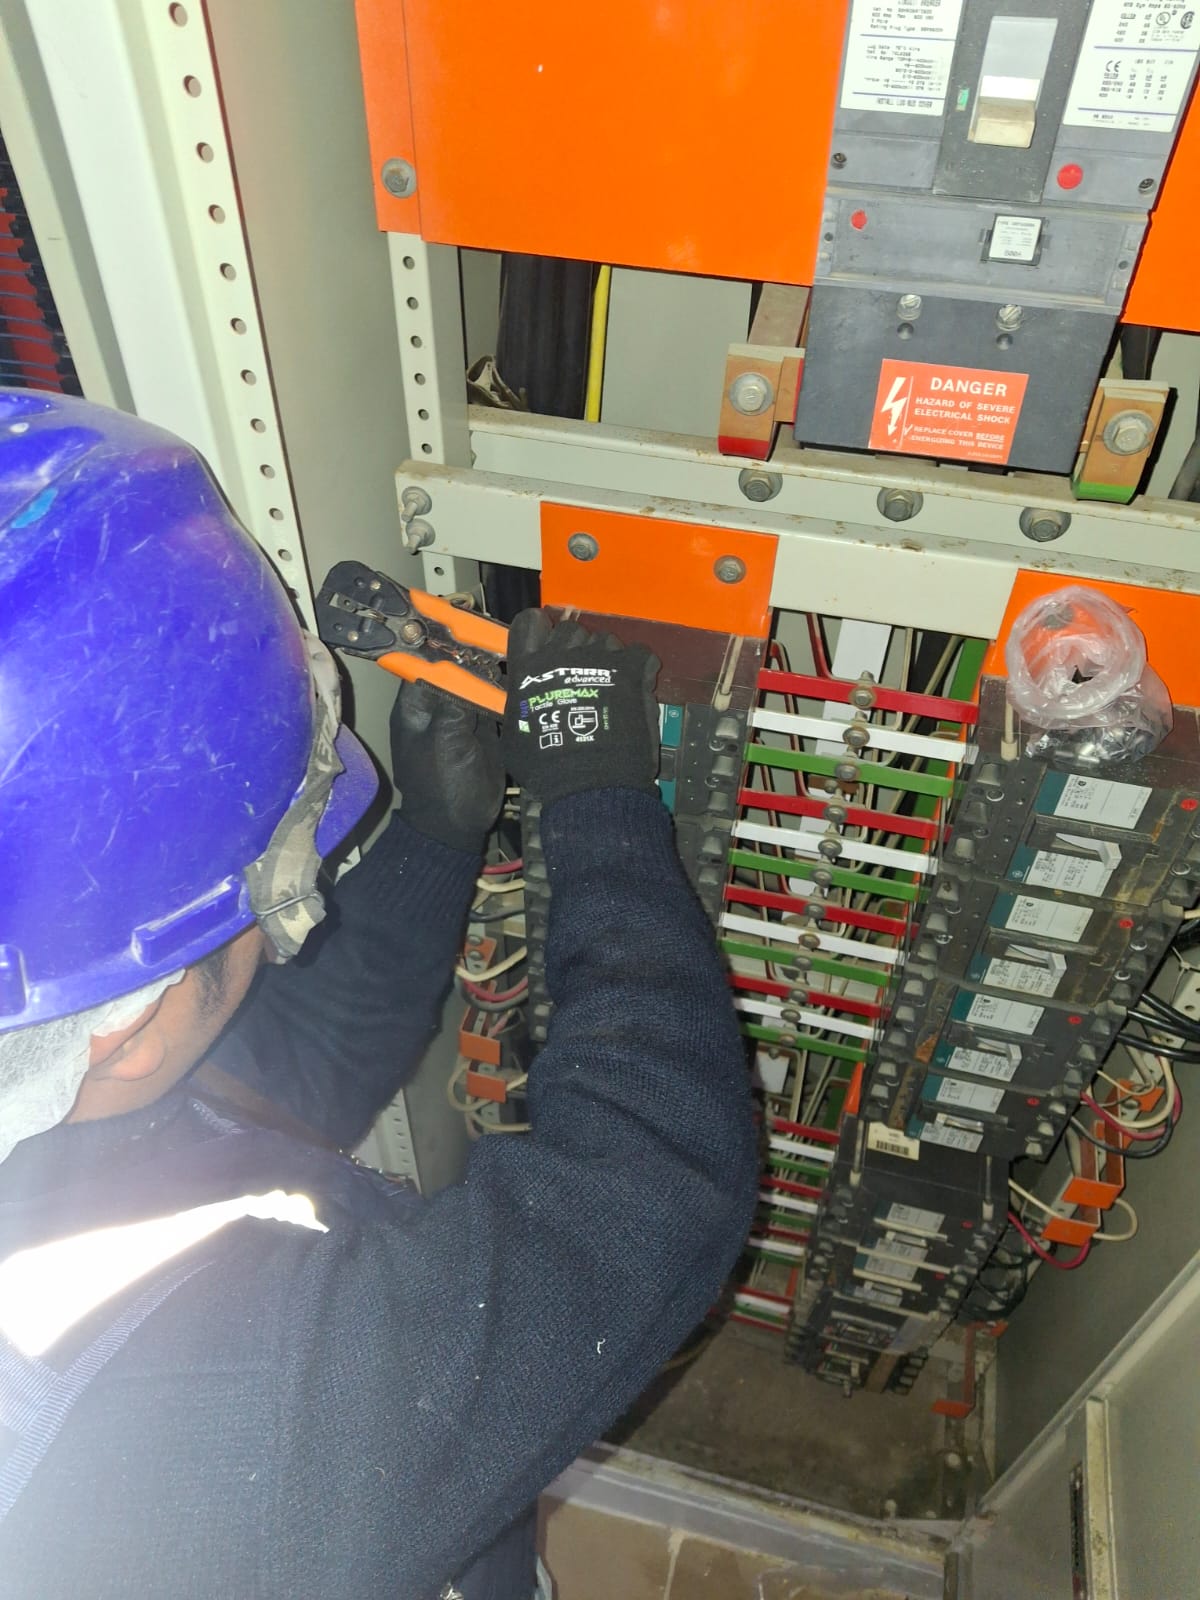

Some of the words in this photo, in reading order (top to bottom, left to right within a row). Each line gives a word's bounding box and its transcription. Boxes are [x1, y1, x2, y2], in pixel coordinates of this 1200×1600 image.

[930, 377, 1008, 397] DANGER
[915, 397, 955, 408] HAZARD
[959, 401, 973, 409] OF
[976, 403, 1016, 414] SEVERE
[914, 408, 972, 421] ELECTRICAL
[976, 414, 1011, 425] SHOCK
[913, 425, 946, 435] REPLACE
[948, 429, 973, 438] COVER
[976, 432, 1005, 442] BEFORE
[564, 674, 612, 685] advanced
[528, 688, 599, 707] PLUREMAX
[557, 698, 578, 706] Glove
[538, 710, 561, 725] CE
